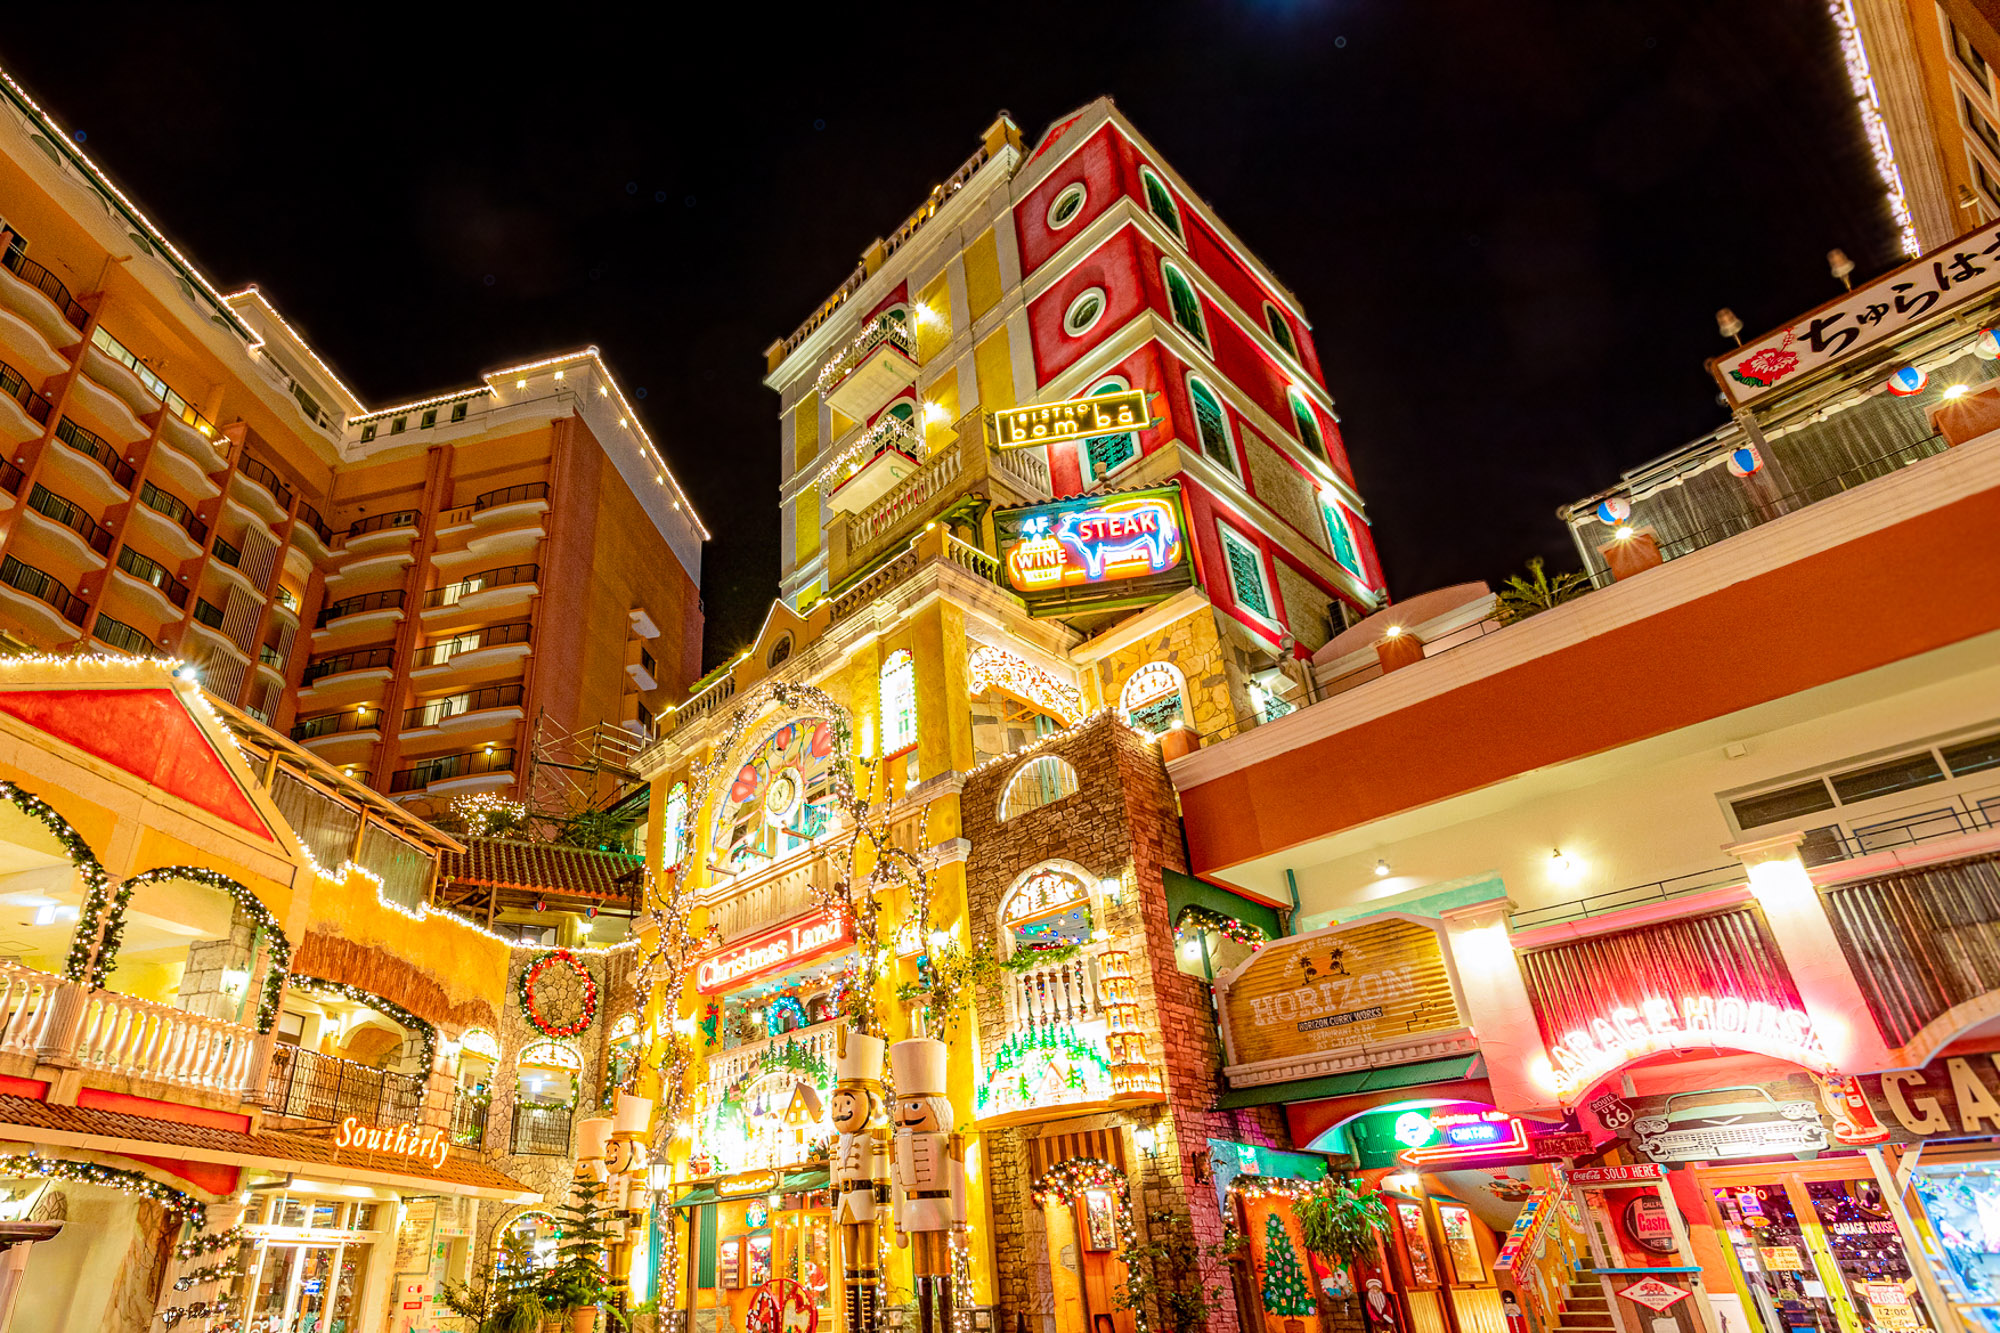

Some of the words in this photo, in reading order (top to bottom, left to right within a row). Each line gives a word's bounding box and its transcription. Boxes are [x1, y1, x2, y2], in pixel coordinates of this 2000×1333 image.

[1796, 232, 2000, 358] ちゅらは
[1019, 403, 1090, 423] BISTRO
[1022, 516, 1049, 534] 4F
[1079, 512, 1157, 541] STEAK
[1017, 549, 1068, 569] WINE
[699, 938, 789, 987] Christmas
[790, 909, 843, 955] Land
[1250, 966, 1415, 1027] HORIZON
[1299, 1018, 1329, 1032] HORIZON
[1329, 1013, 1353, 1025] CURRY
[1354, 1008, 1382, 1021] WORKS
[1592, 1094, 1614, 1109] ROUTE
[1881, 1053, 2000, 1135] GA
[1606, 1108, 1629, 1127] 66
[335, 1116, 450, 1170] Southerly
[1603, 1167, 1628, 1180] SOLD
[1631, 1164, 1656, 1177] HERE
[1833, 1221, 1868, 1235] GARAGE
[1651, 1238, 1670, 1247] HERE
[1870, 1291, 1906, 1304] CLOSED
